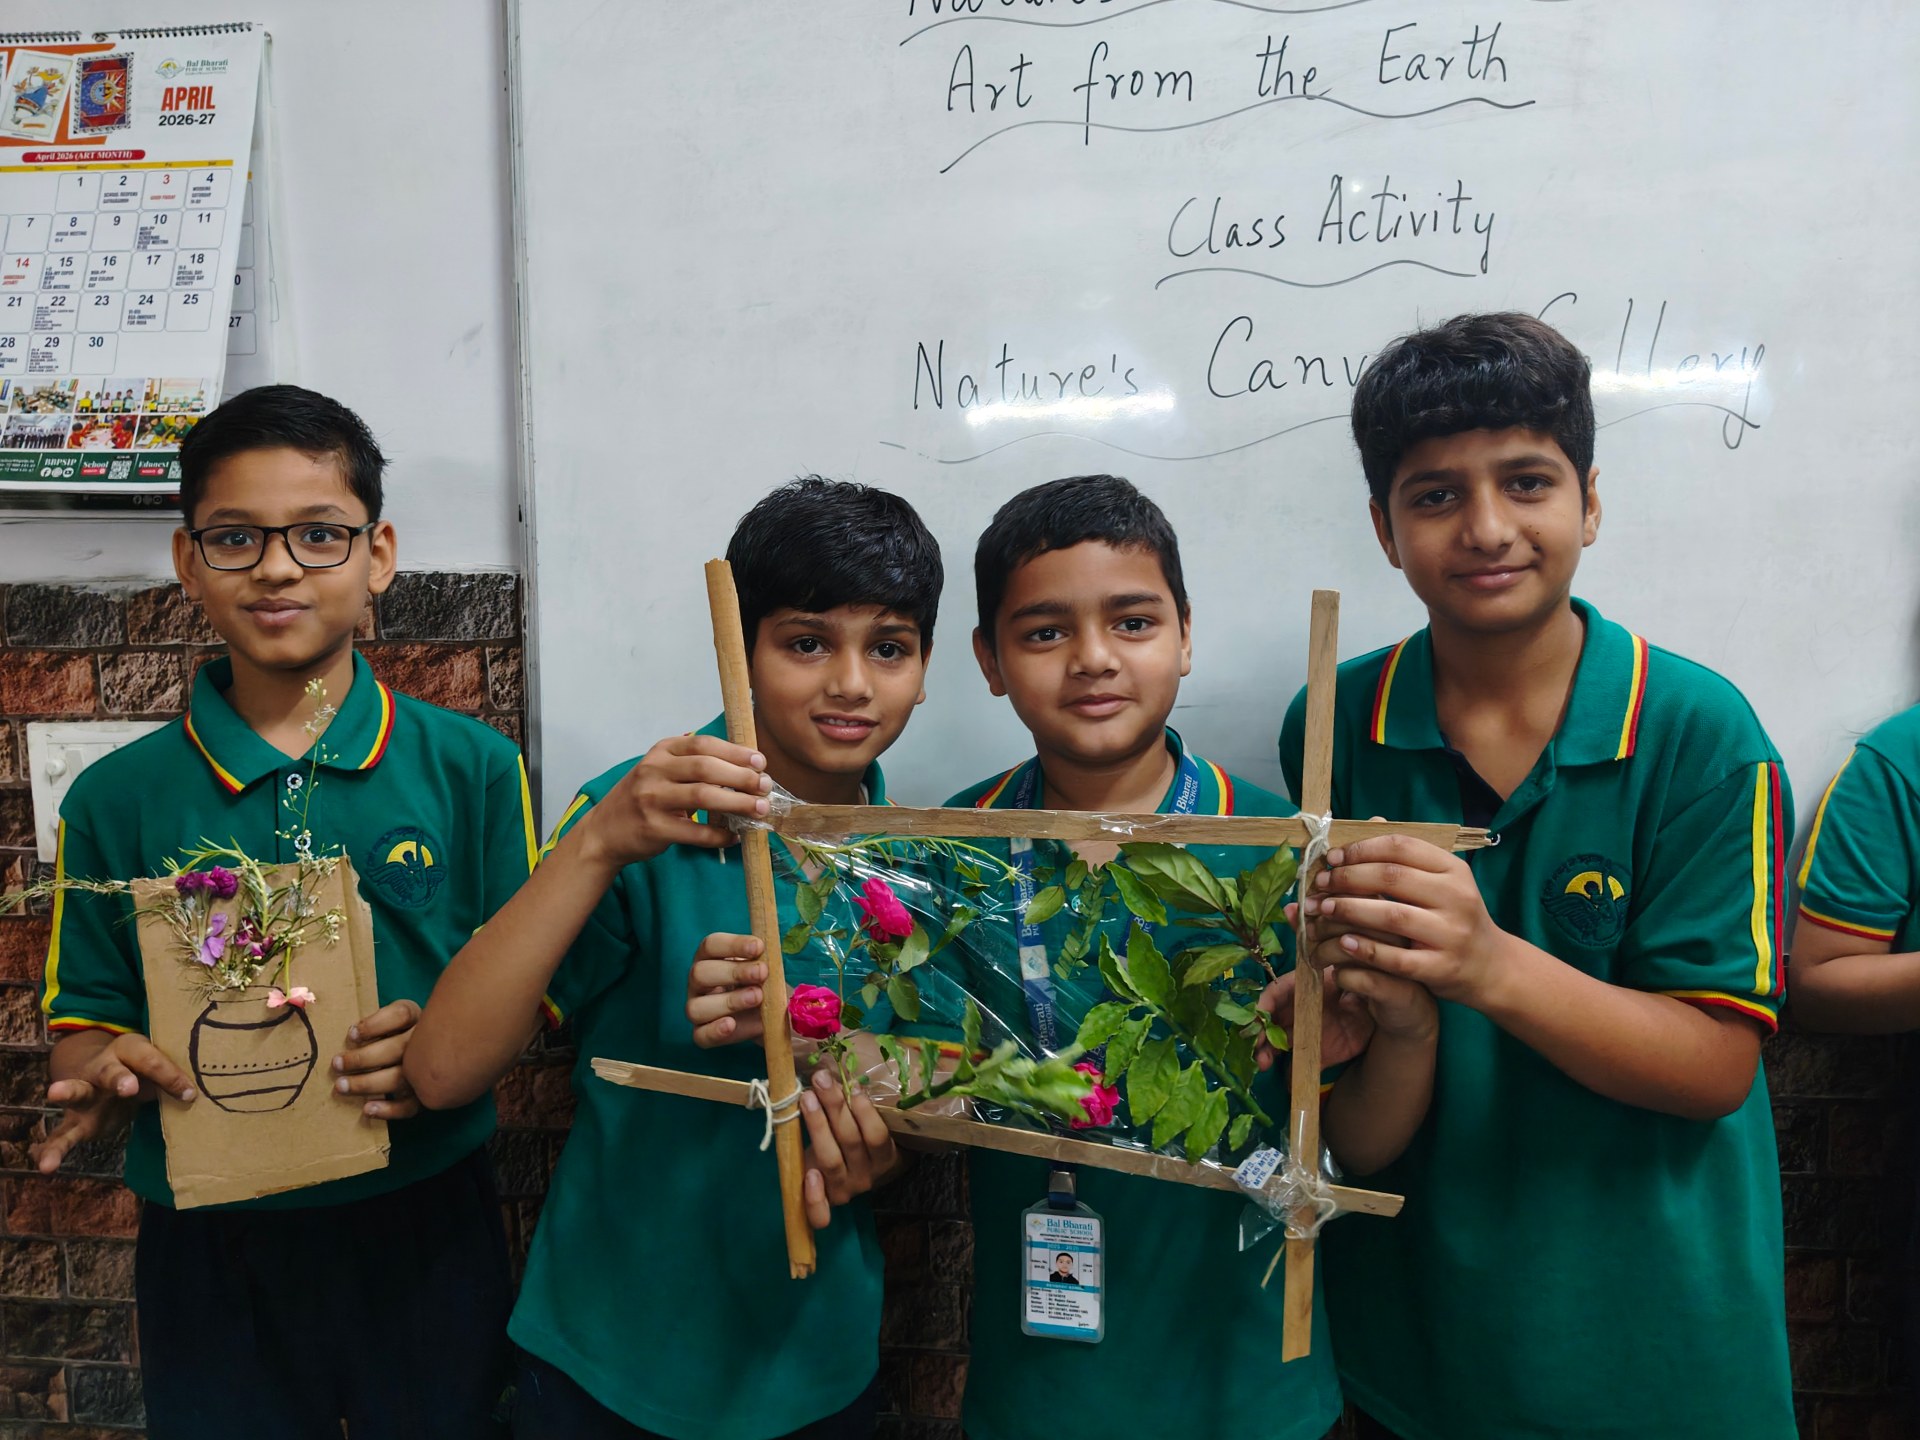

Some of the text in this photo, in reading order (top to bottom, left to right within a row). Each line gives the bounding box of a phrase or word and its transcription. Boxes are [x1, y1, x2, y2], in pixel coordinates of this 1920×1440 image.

[945, 22, 1507, 146] Art from the Earth
[160, 86, 216, 112] APRIL
[158, 114, 216, 126] 2026-27
[35, 153, 55, 162] April
[57, 152, 74, 160] 2026
[74, 152, 95, 160] (ART
[77, 177, 83, 186] 1
[119, 176, 127, 186] 2
[162, 174, 170, 184] 3
[206, 173, 214, 183] 4
[27, 218, 34, 228] 7
[70, 217, 78, 227] 8
[113, 216, 121, 226] 9
[153, 214, 167, 225] 10
[197, 213, 211, 223] 11
[1168, 174, 1497, 274] Class Activity
[15, 257, 30, 268] 14
[59, 257, 73, 267] 15
[102, 256, 117, 266] 16
[146, 255, 161, 265] 17
[190, 253, 205, 264] 18
[7, 297, 22, 307] 21
[51, 296, 66, 306] 22
[94, 295, 109, 306] 23
[138, 295, 154, 305] 24
[183, 294, 199, 304] 25
[229, 316, 241, 327] 27
[0, 337, 15, 348] 28
[44, 337, 60, 347] 29
[88, 336, 104, 347] 30
[913, 338, 1139, 411] Nature's
[1176, 773, 1193, 810] Bharati
[1188, 779, 1198, 806] SCHOOL
[1044, 1002, 1056, 1037] SCHOOL
[1033, 1003, 1049, 1048] Bharati
[1047, 1219, 1093, 1230] Bal Bharati
